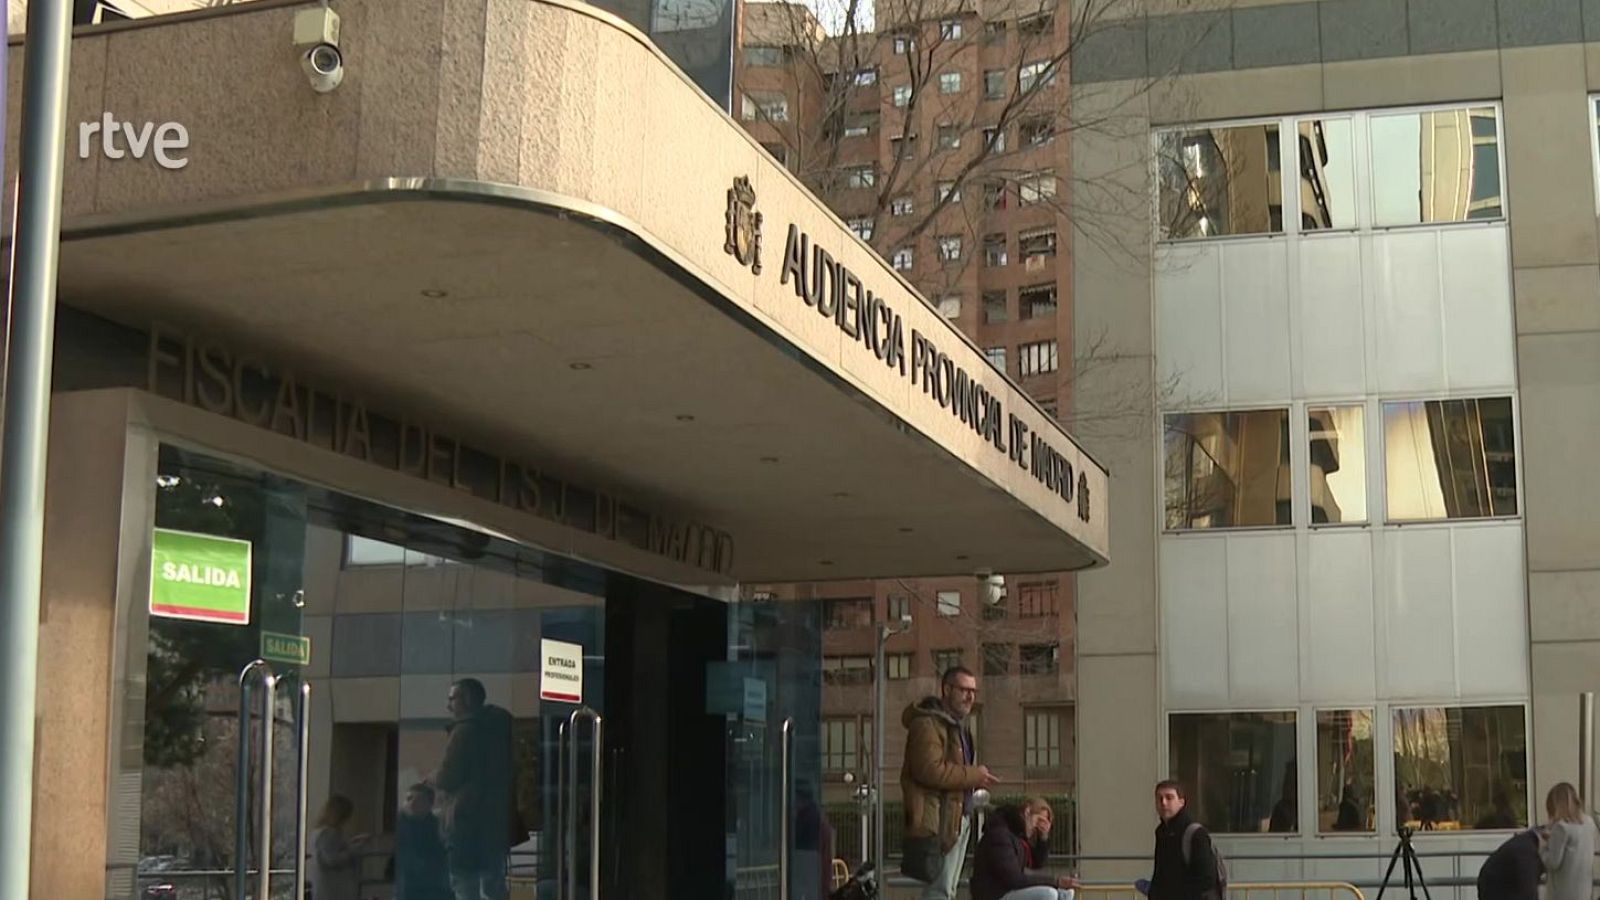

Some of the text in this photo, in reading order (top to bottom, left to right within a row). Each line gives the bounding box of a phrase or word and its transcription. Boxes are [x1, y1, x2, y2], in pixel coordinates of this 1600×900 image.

[780, 223, 1074, 503] AUDIENCIA PROVINCIAL DE MADRID
[398, 420, 471, 490] DEL
[594, 487, 629, 543] DE
[646, 512, 734, 574] MADRID
[162, 561, 241, 589] SALIDA
[266, 638, 305, 658] SALIDA
[548, 656, 576, 668] ENTRADA
